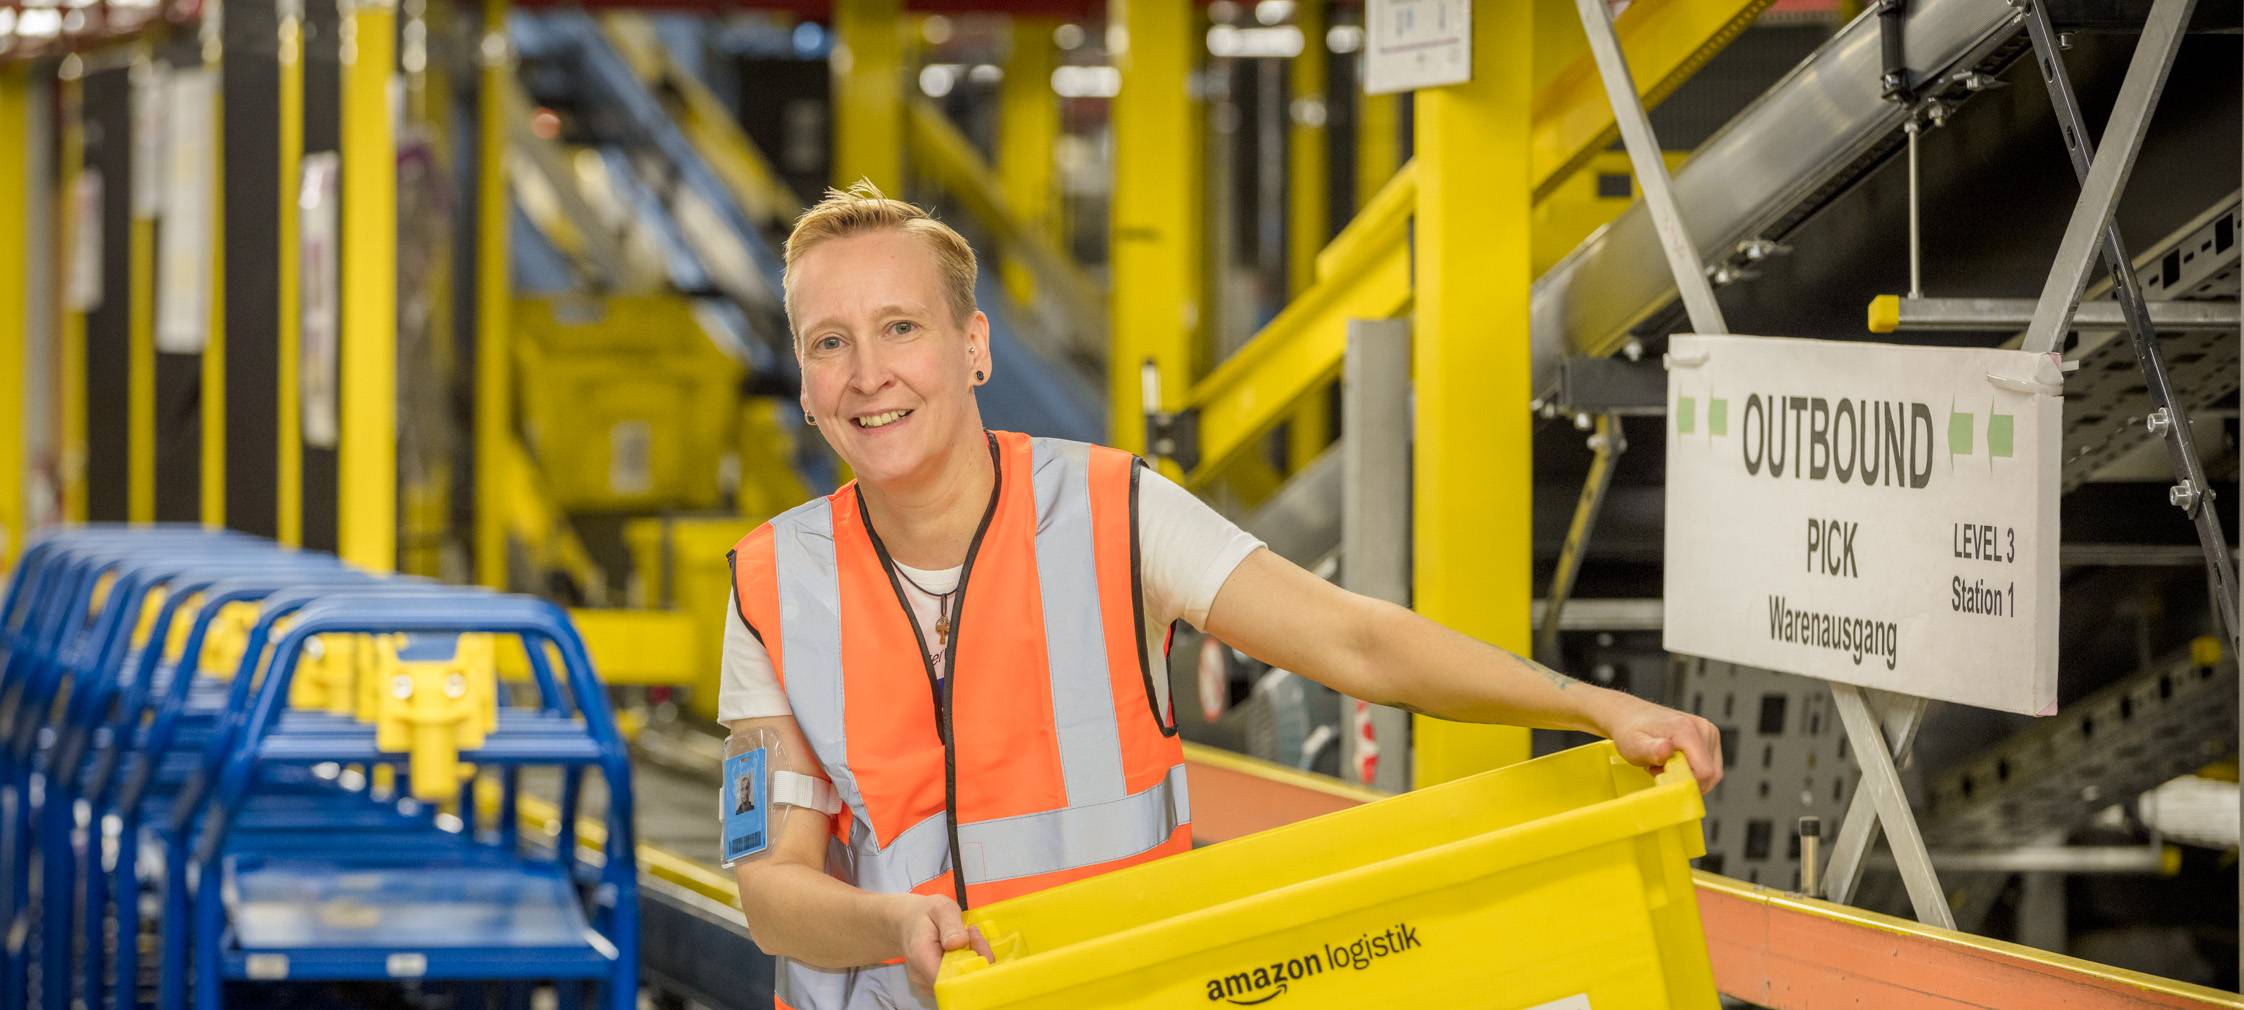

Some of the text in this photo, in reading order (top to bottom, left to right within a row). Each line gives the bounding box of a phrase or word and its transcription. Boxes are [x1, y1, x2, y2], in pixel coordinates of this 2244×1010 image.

[1743, 393, 1934, 489] OUTBOUND
[1807, 518, 1858, 578] PICK
[1953, 523, 2015, 564] LEVEL 3
[1951, 575, 2014, 618] Station 1
[1769, 595, 1897, 670] Warenausgang
[1206, 923, 1421, 1001] amazon logistik
